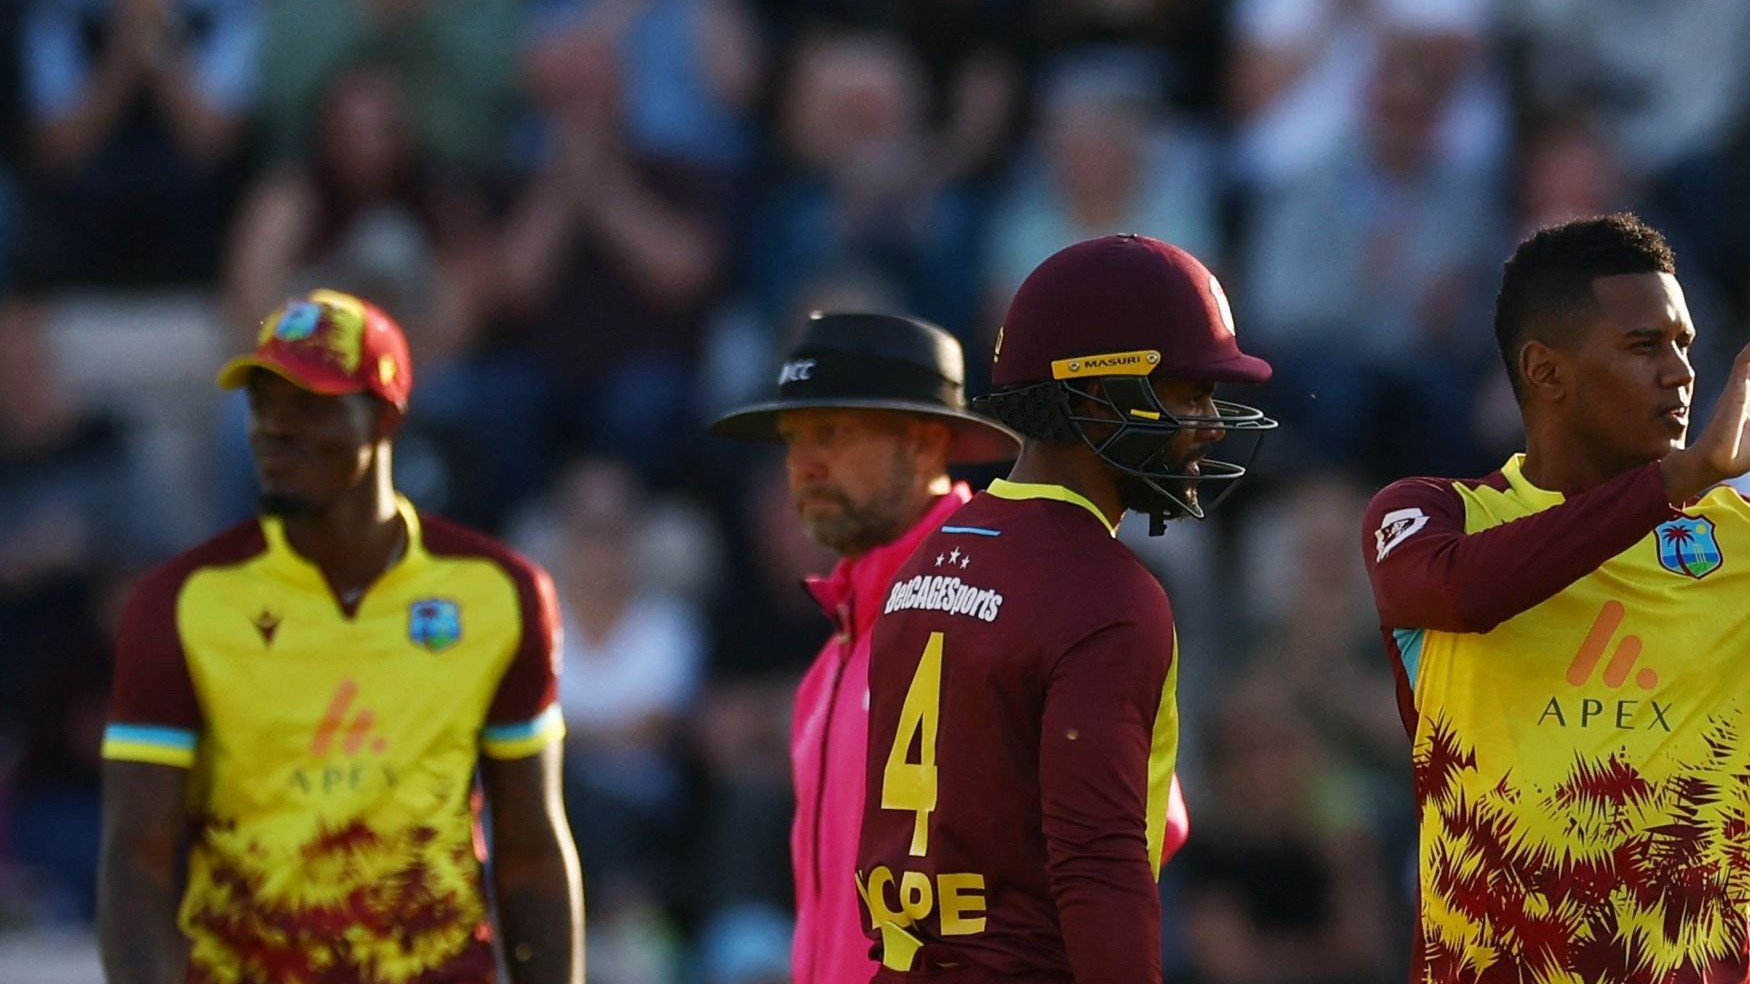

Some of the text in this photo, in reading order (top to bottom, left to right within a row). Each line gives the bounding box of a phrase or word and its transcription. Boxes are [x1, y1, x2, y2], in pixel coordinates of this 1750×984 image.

[1083, 356, 1141, 369] MASURI
[884, 575, 1003, 621] BetCAGESports
[1537, 696, 1673, 732] APEX
[881, 632, 944, 856] 4
